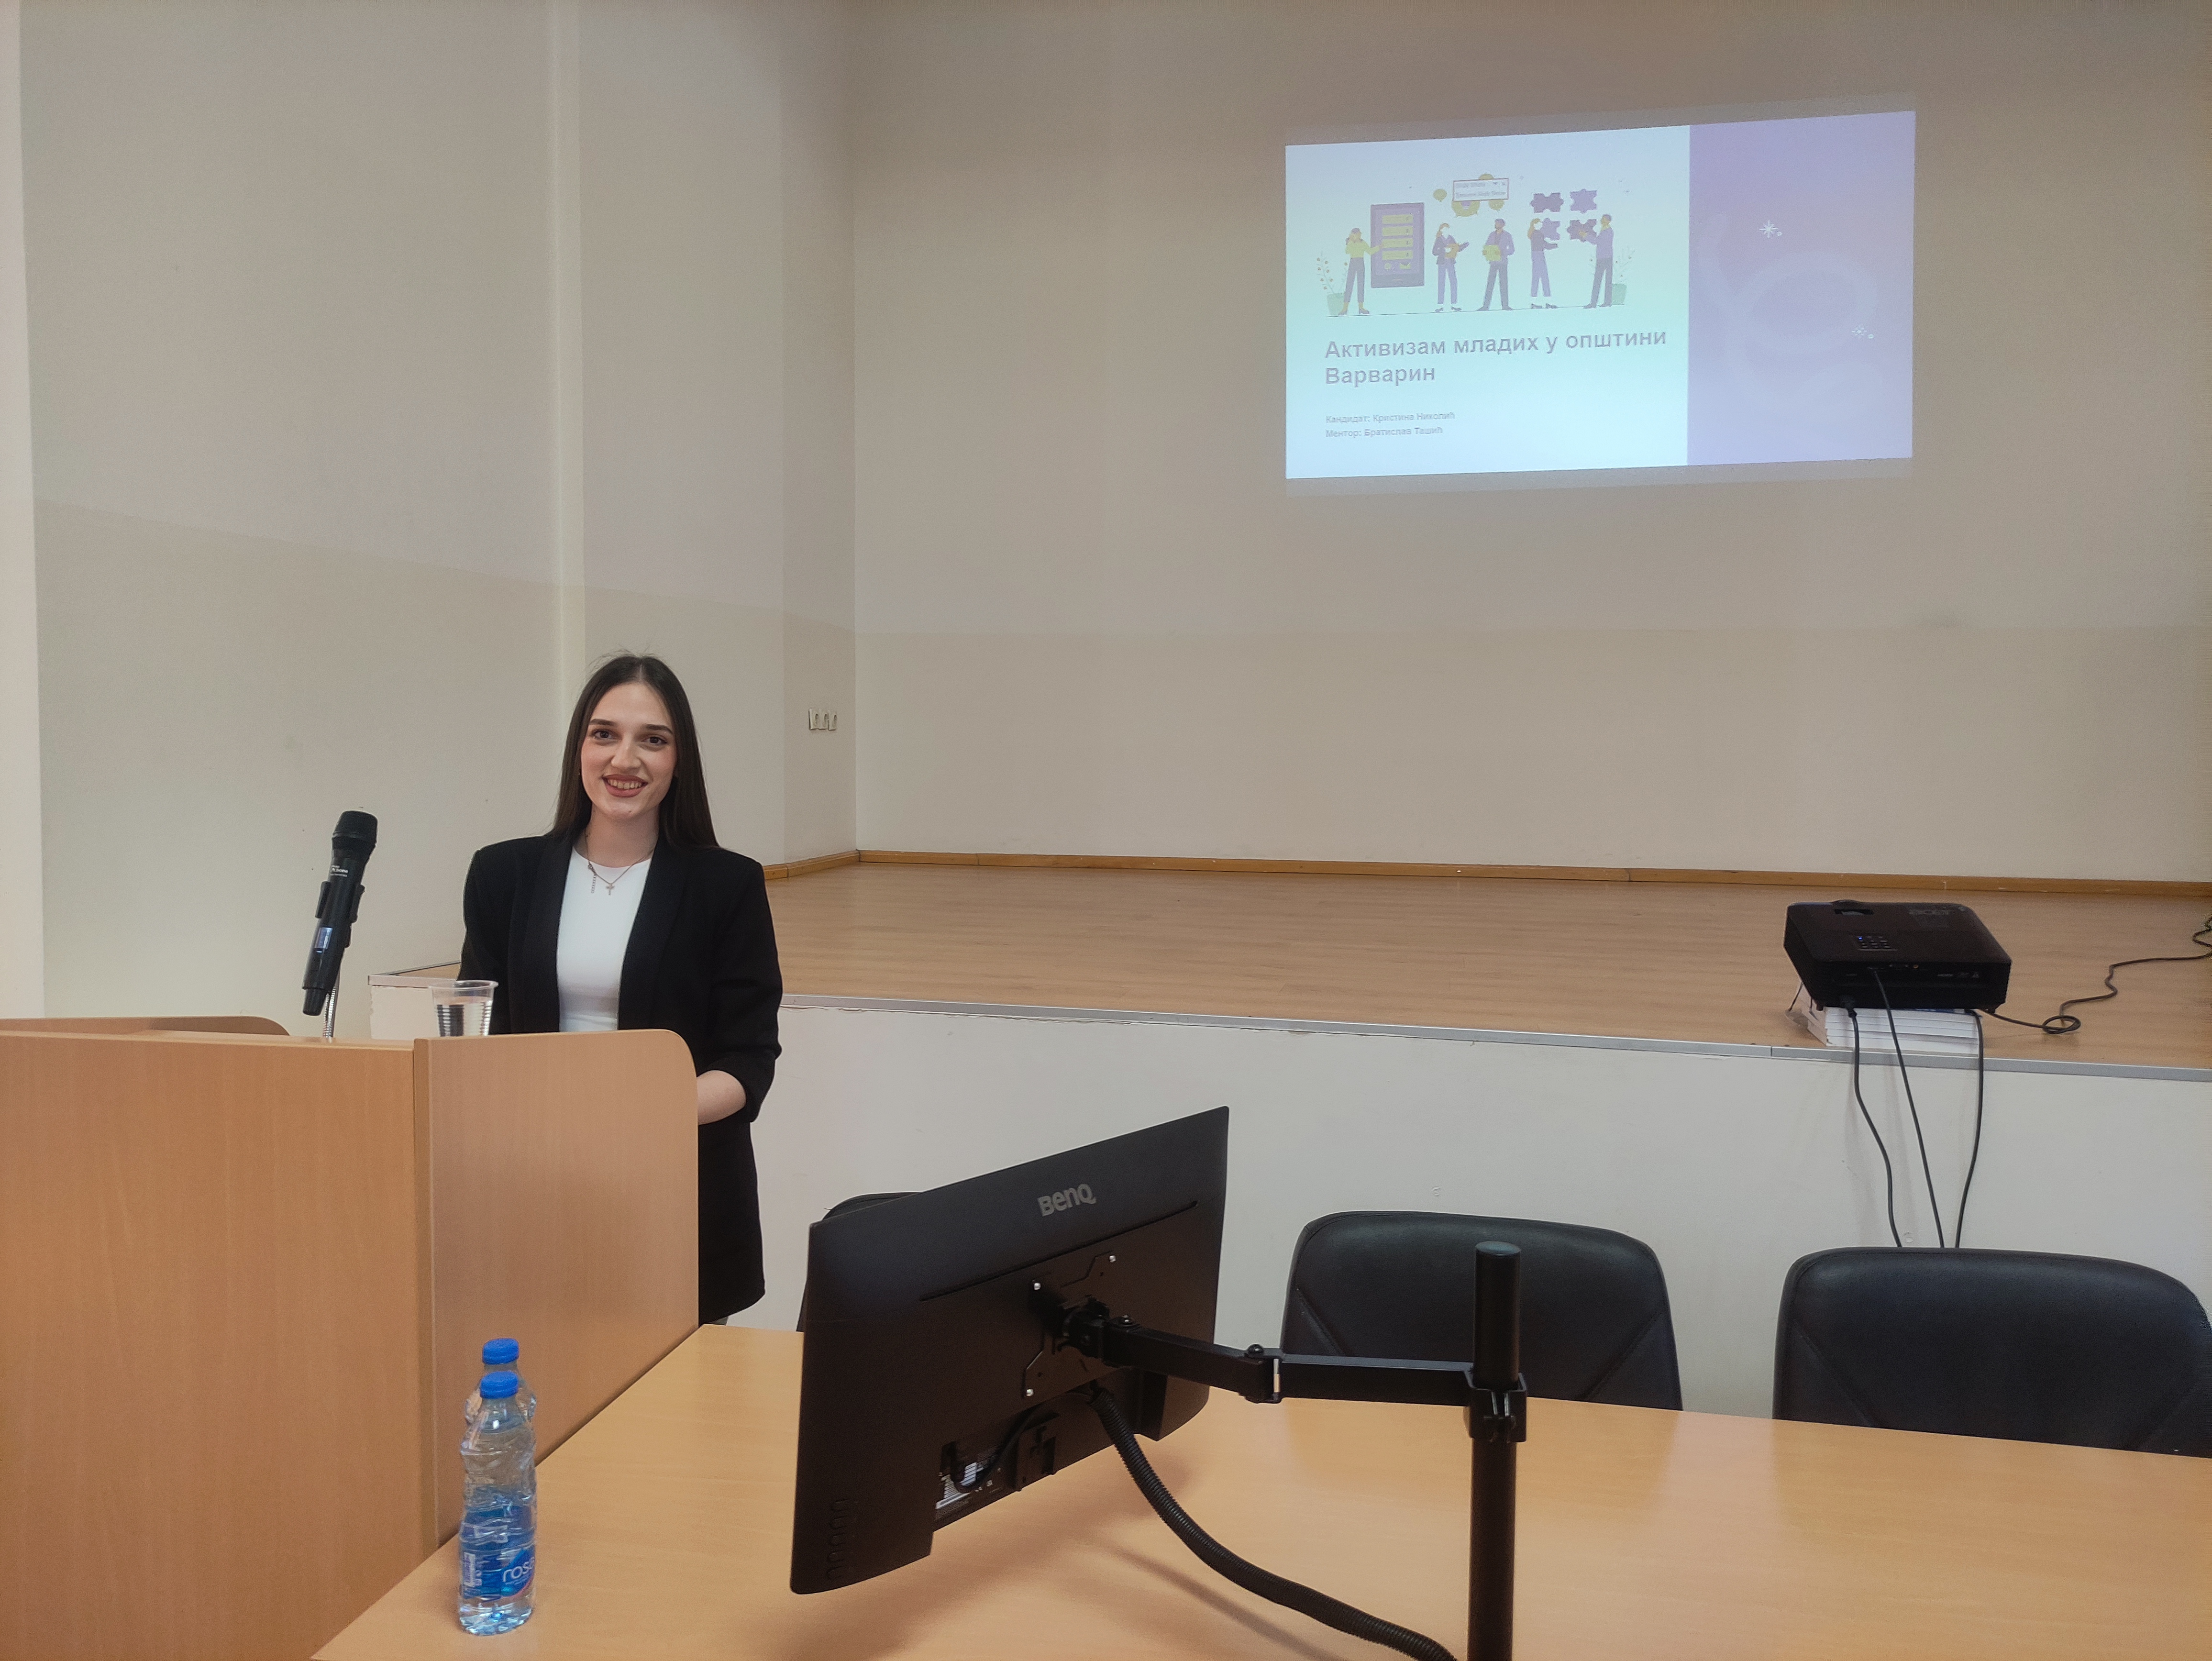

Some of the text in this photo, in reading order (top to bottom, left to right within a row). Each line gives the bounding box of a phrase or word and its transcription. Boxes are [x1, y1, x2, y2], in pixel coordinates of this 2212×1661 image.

[1325, 332, 1667, 358] Активизам младих у општини
[1326, 367, 1435, 387] Варварин
[1037, 1184, 1096, 1217] BenQ
